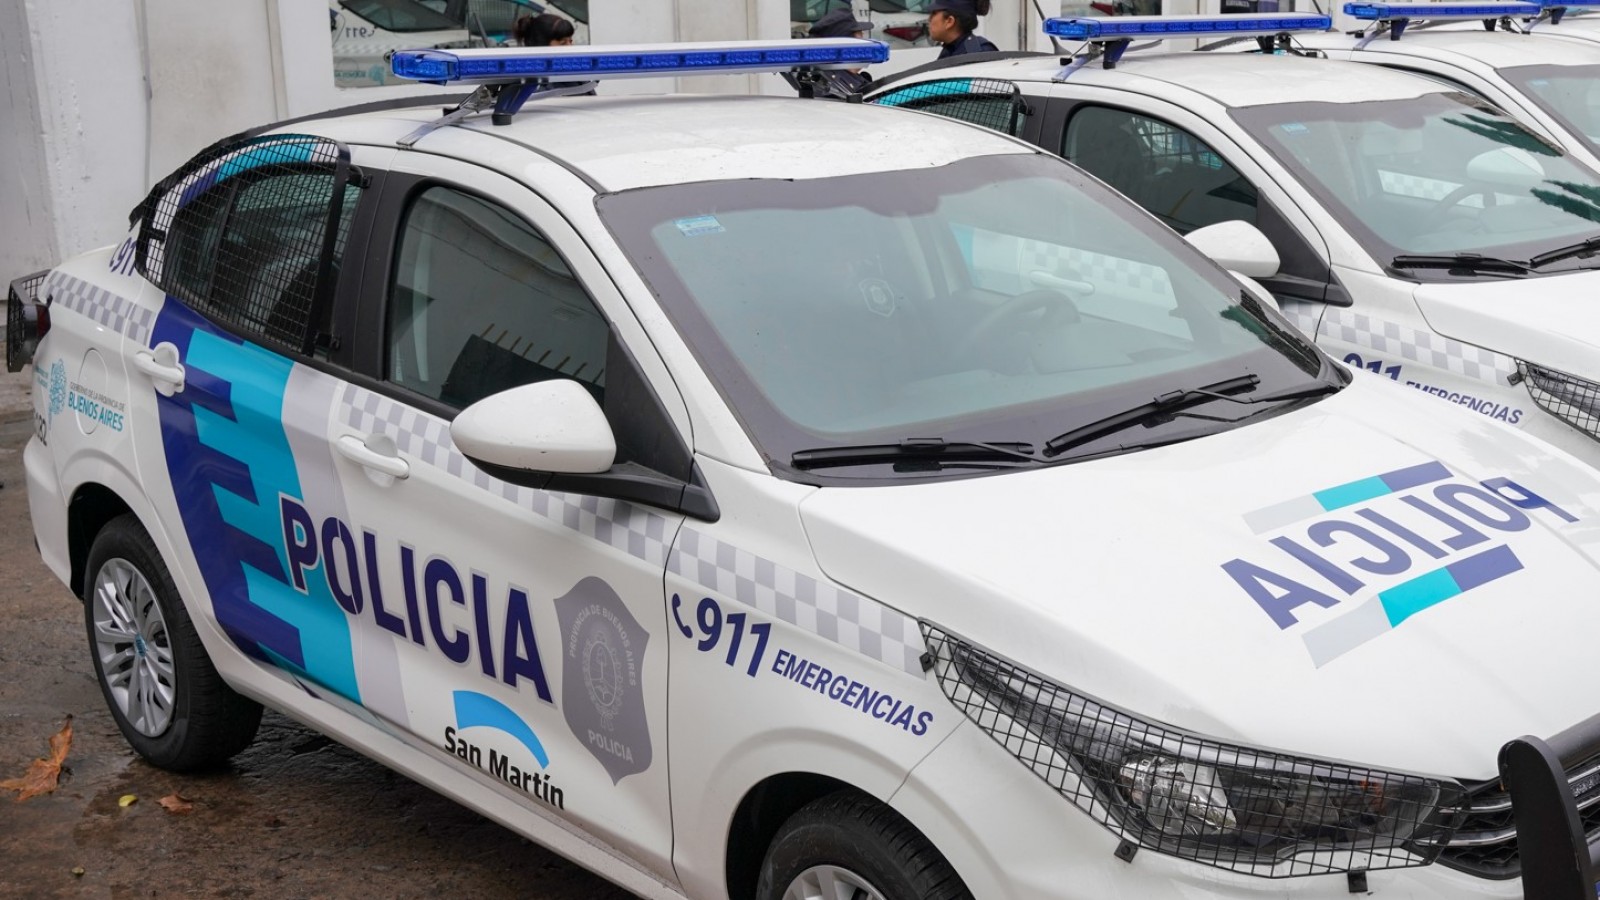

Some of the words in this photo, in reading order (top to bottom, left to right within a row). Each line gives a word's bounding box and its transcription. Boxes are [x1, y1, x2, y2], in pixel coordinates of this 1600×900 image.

[68, 391, 99, 420] BUENOS
[98, 407, 124, 432] AIRES
[1405, 381, 1523, 424] ERGENCIAS
[279, 493, 556, 706] POLICIA
[569, 606, 591, 658] PROVINCIA
[590, 604, 602, 616] DE
[602, 607, 631, 648] BUENOS
[625, 650, 636, 686] AIRES
[696, 597, 771, 678] 911
[771, 649, 934, 736] EMERGENCIAS
[444, 725, 482, 770] San
[488, 747, 565, 810] Martín
[587, 728, 634, 764] POLICIA
